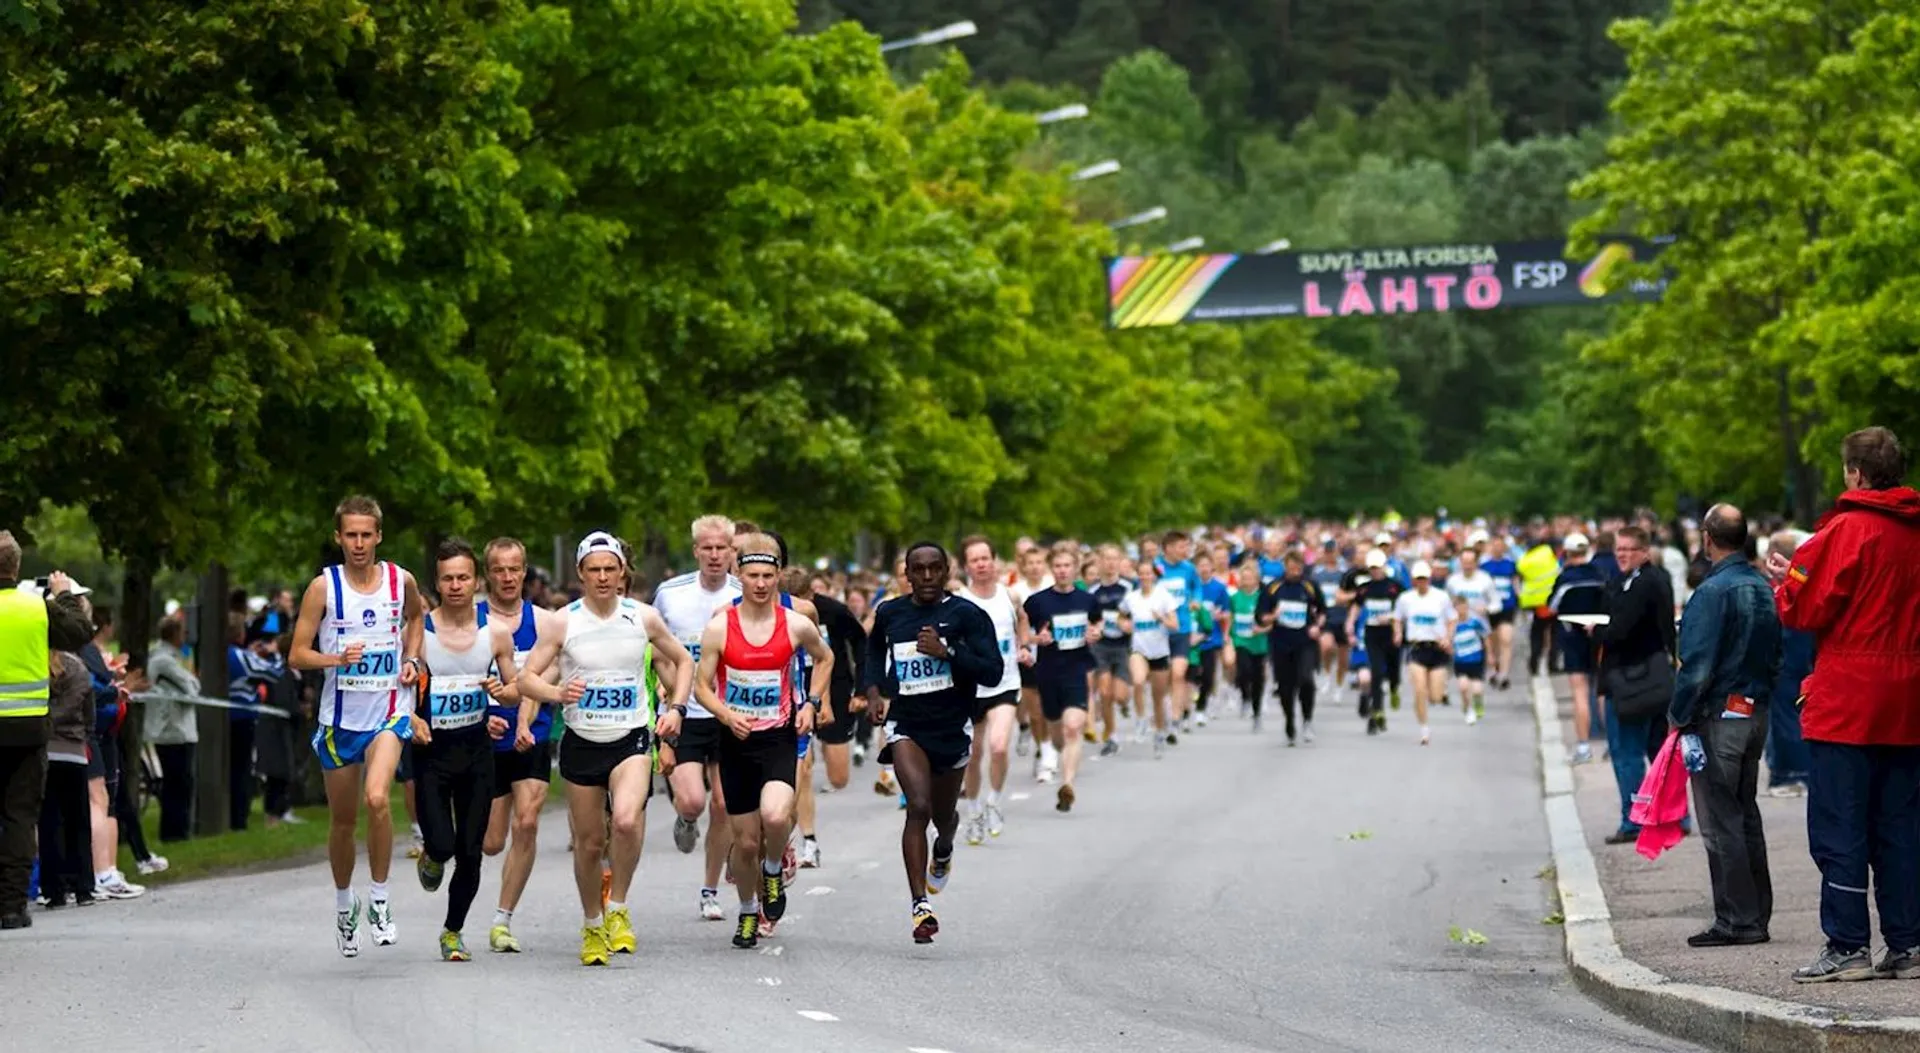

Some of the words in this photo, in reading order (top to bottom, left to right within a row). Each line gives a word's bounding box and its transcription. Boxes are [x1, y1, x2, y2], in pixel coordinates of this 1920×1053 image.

[1413, 245, 1498, 266] FORSSA
[1512, 260, 1568, 289] FSP
[1304, 264, 1502, 317] LÄHTÖ
[900, 658, 946, 680] 7882
[436, 692, 483, 715] 7891
[584, 688, 632, 709] 7538
[729, 684, 775, 707] 7466
